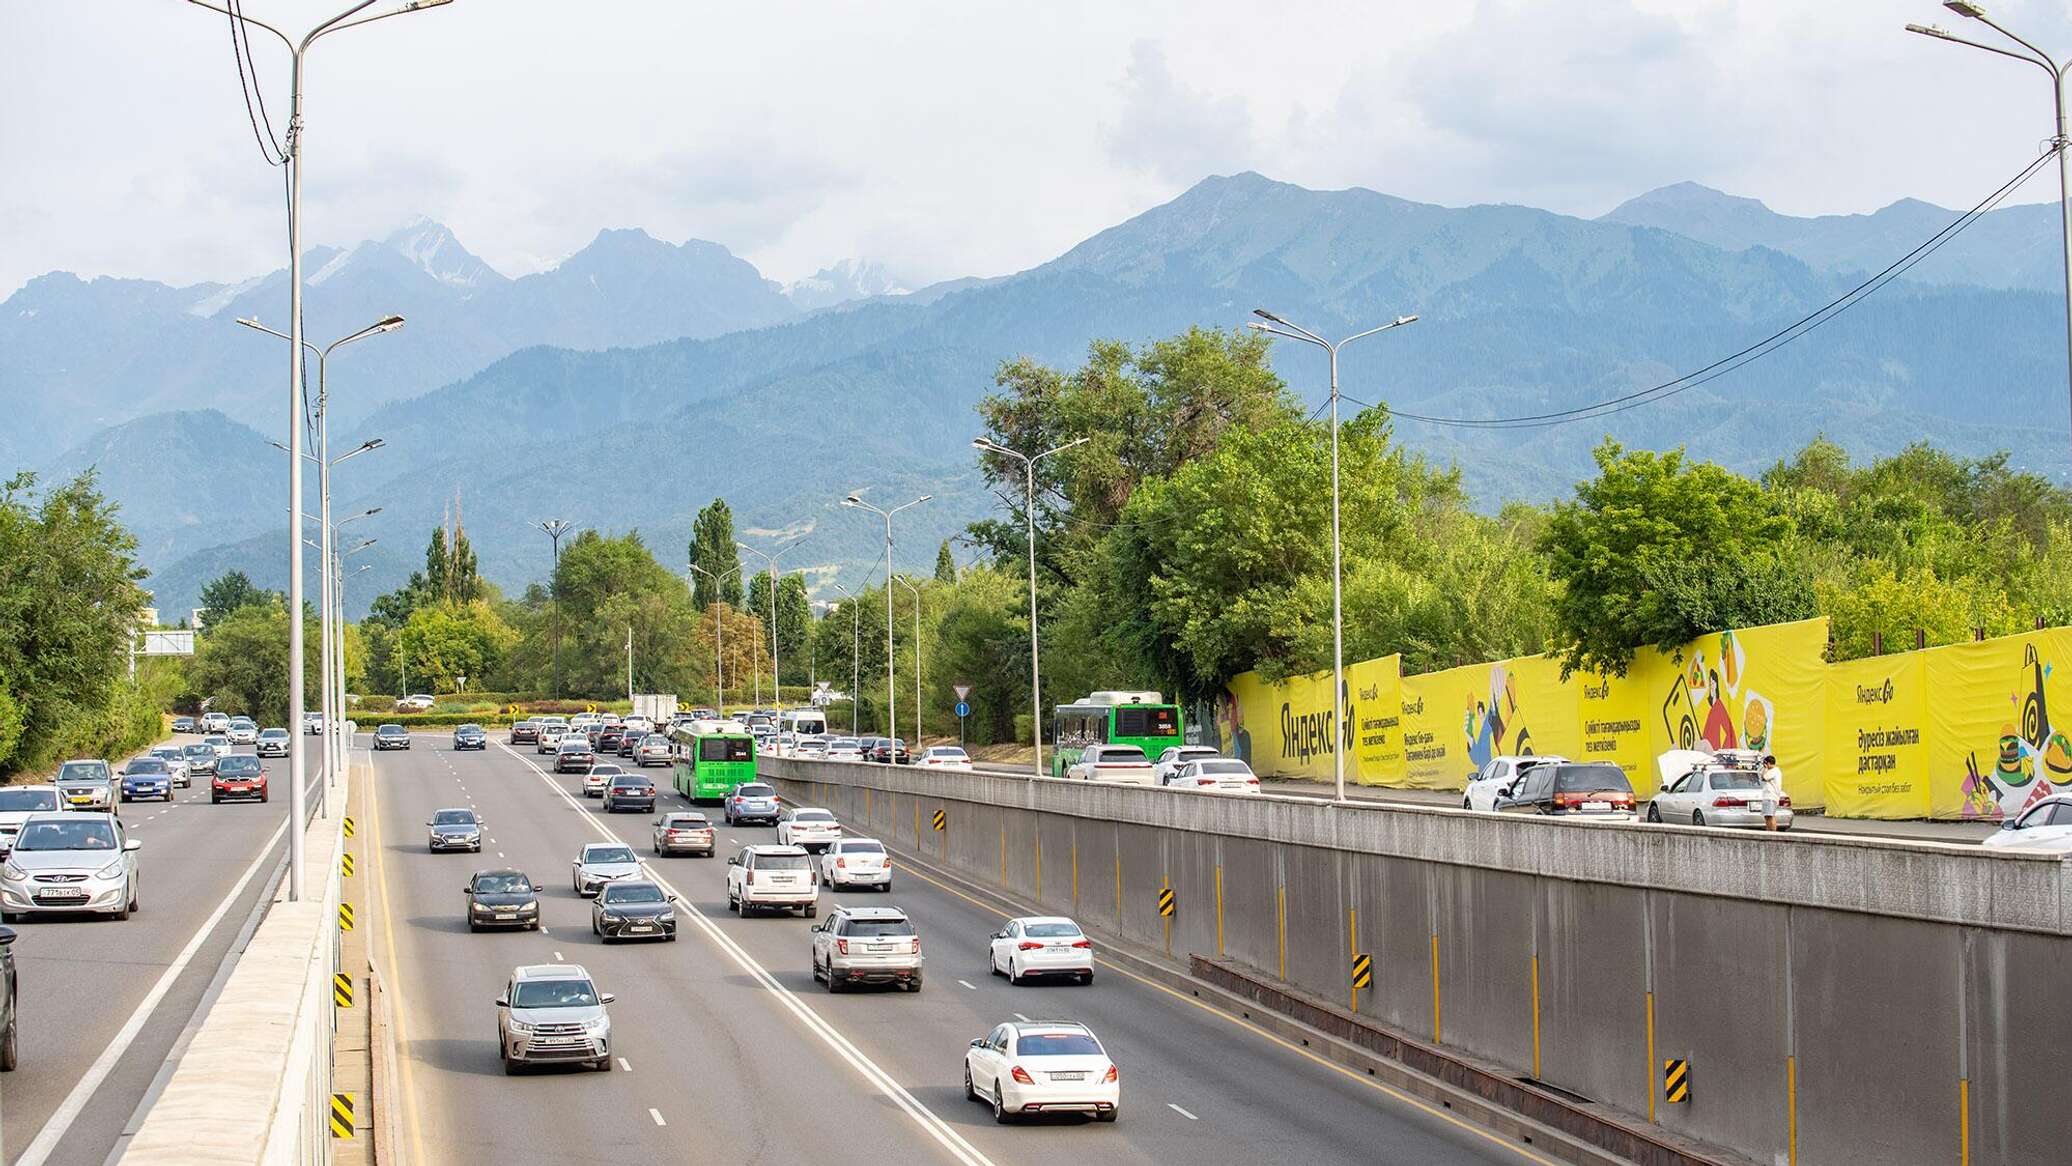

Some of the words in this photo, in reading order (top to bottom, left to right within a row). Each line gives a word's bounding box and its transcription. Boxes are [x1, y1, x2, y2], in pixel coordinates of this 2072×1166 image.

[1857, 685, 1882, 704] Яндекс
[1883, 678, 1894, 704] Go
[1281, 702, 1334, 766] Яндекс
[1858, 755, 1896, 775] дастарқан
